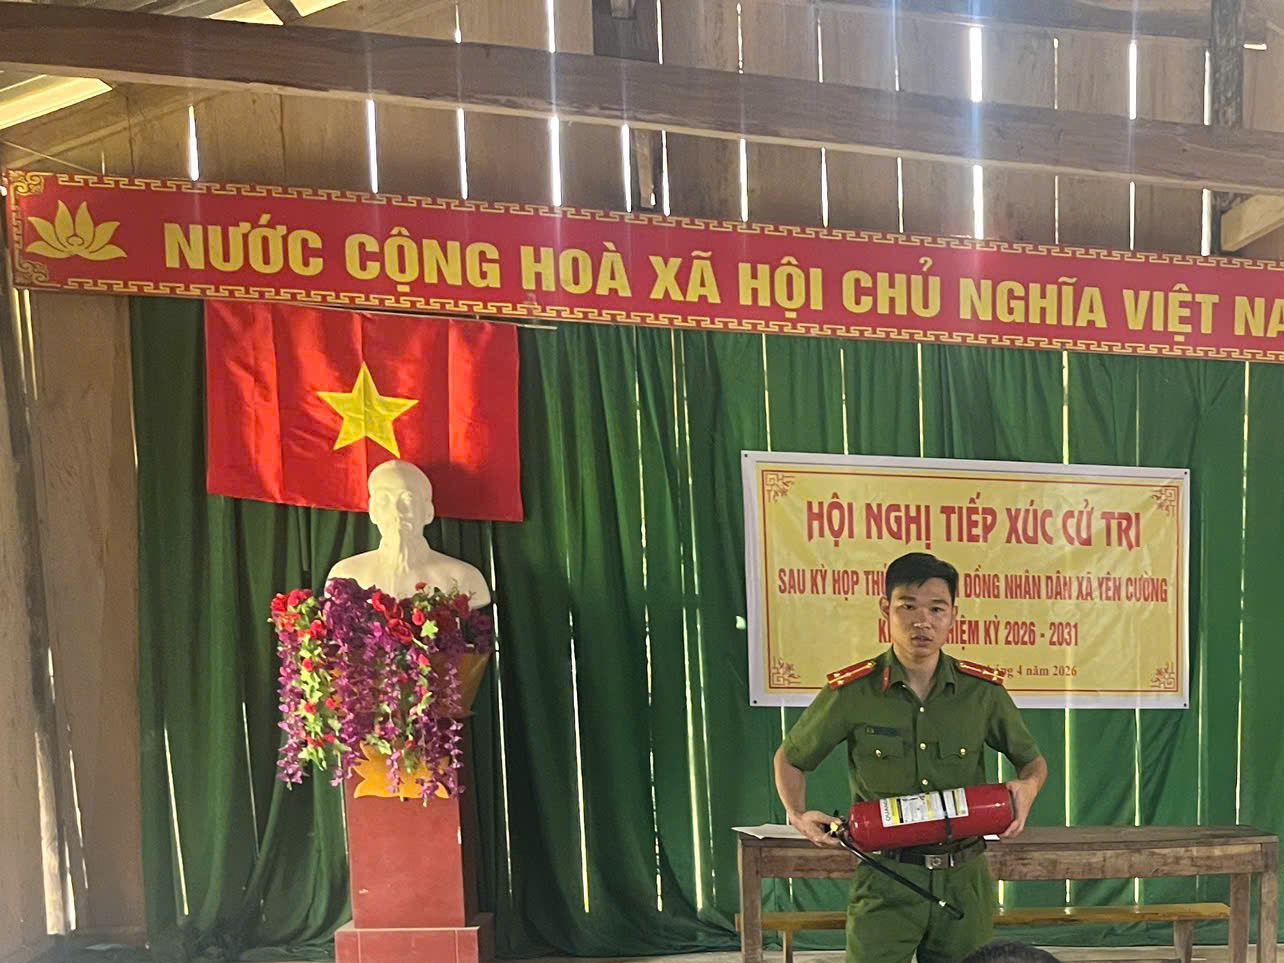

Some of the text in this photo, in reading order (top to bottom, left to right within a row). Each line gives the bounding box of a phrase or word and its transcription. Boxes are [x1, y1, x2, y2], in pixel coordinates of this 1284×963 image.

[163, 213, 323, 276] NƯỚC
[345, 226, 501, 292] CỘNG
[520, 241, 632, 297] HOÀ
[649, 251, 721, 304] XÃ
[738, 255, 823, 319] HỘI
[842, 257, 941, 318] CHỦ
[959, 276, 1108, 328] NGHĨA
[1122, 283, 1219, 342] VIỆT
[807, 492, 855, 547] HỘI
[865, 502, 931, 549] NGHỊ
[939, 491, 998, 543] TIẾP
[1005, 499, 1054, 545] XÚC
[1061, 498, 1095, 546] CỬ
[778, 568, 806, 594] SAU
[810, 564, 828, 594] KỲ
[832, 569, 860, 601] HỌP
[1004, 569, 1042, 599] NHÂN
[1045, 570, 1072, 600] DÂN
[1077, 571, 1094, 601] XÃ
[1097, 571, 1121, 601] YÊN
[1125, 570, 1168, 602] CƯỜNG
[983, 615, 1000, 645] KỲ
[1004, 621, 1036, 646] 2026
[1049, 622, 1079, 646] 2031
[1016, 664, 1022, 676] 4
[1026, 665, 1049, 676] năm
[1053, 664, 1077, 676] 2026
